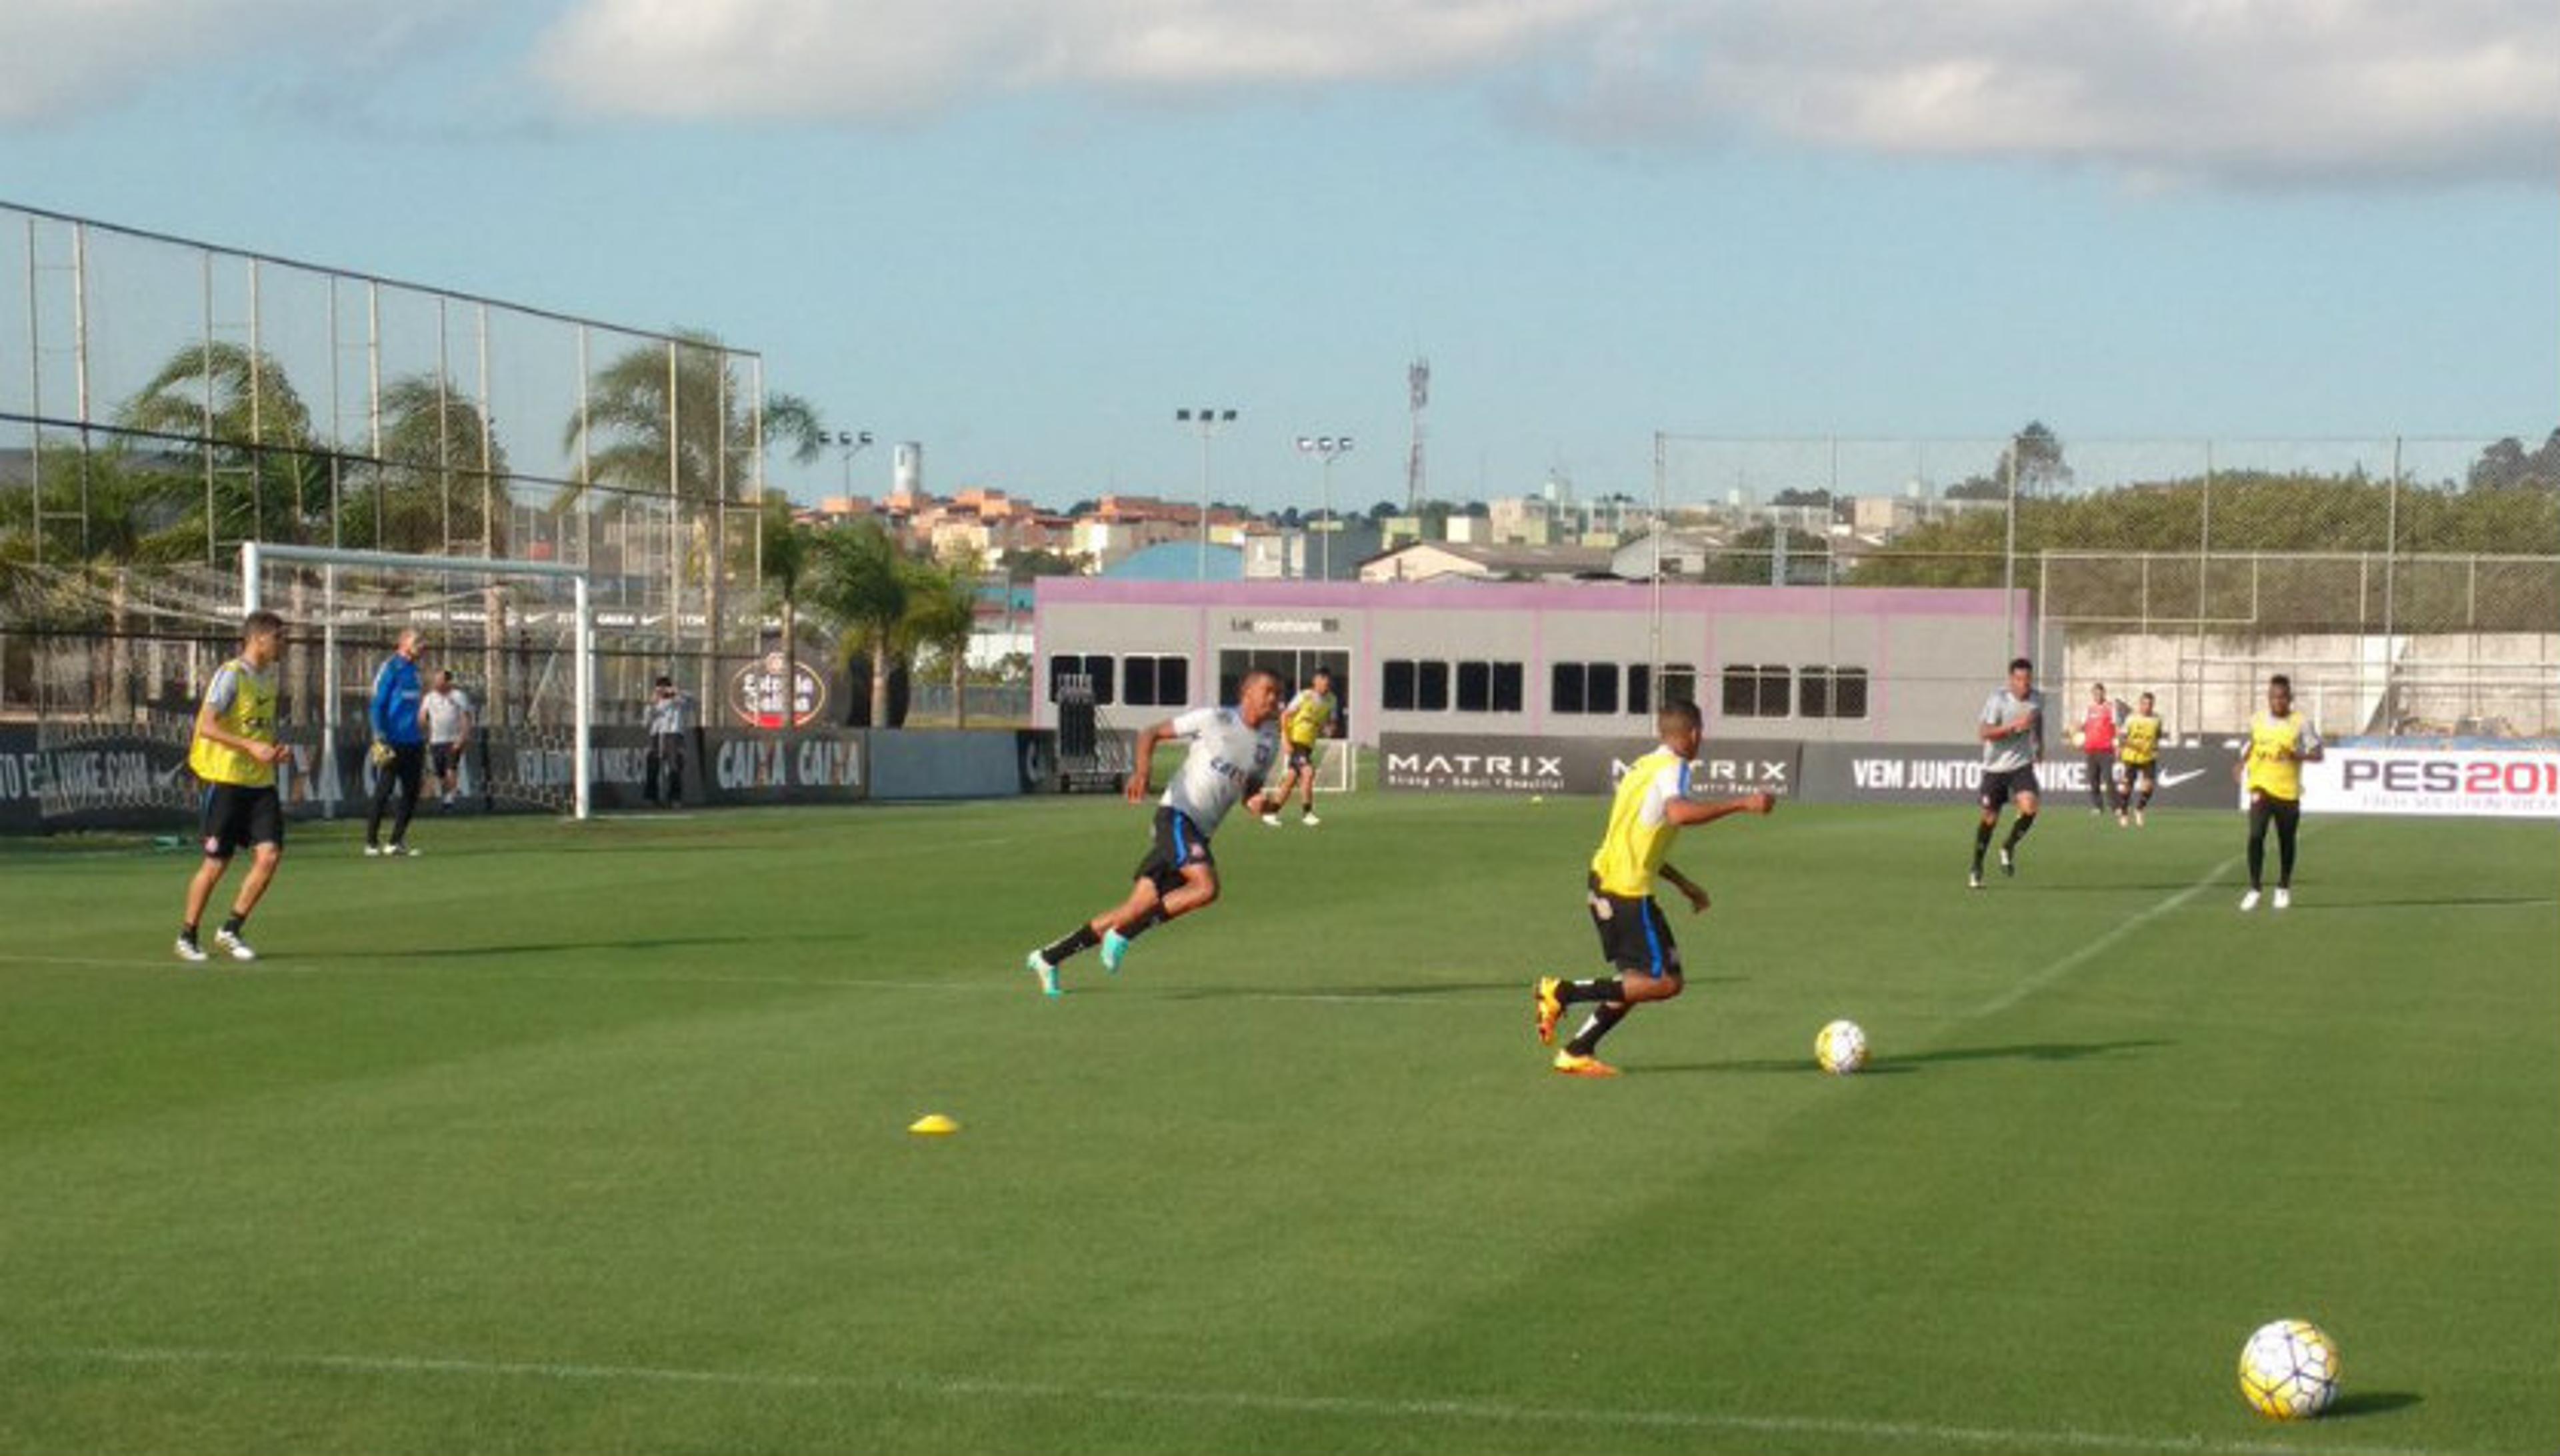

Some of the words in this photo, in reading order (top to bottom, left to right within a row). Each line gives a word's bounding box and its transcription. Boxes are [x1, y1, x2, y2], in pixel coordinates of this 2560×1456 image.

[717, 739, 786, 789] CAIXA
[799, 739, 861, 785] CAIXA
[1387, 753, 1562, 777] MATRIX
[1853, 760, 1902, 788] VEM
[1909, 761, 1982, 789] JUNTO
